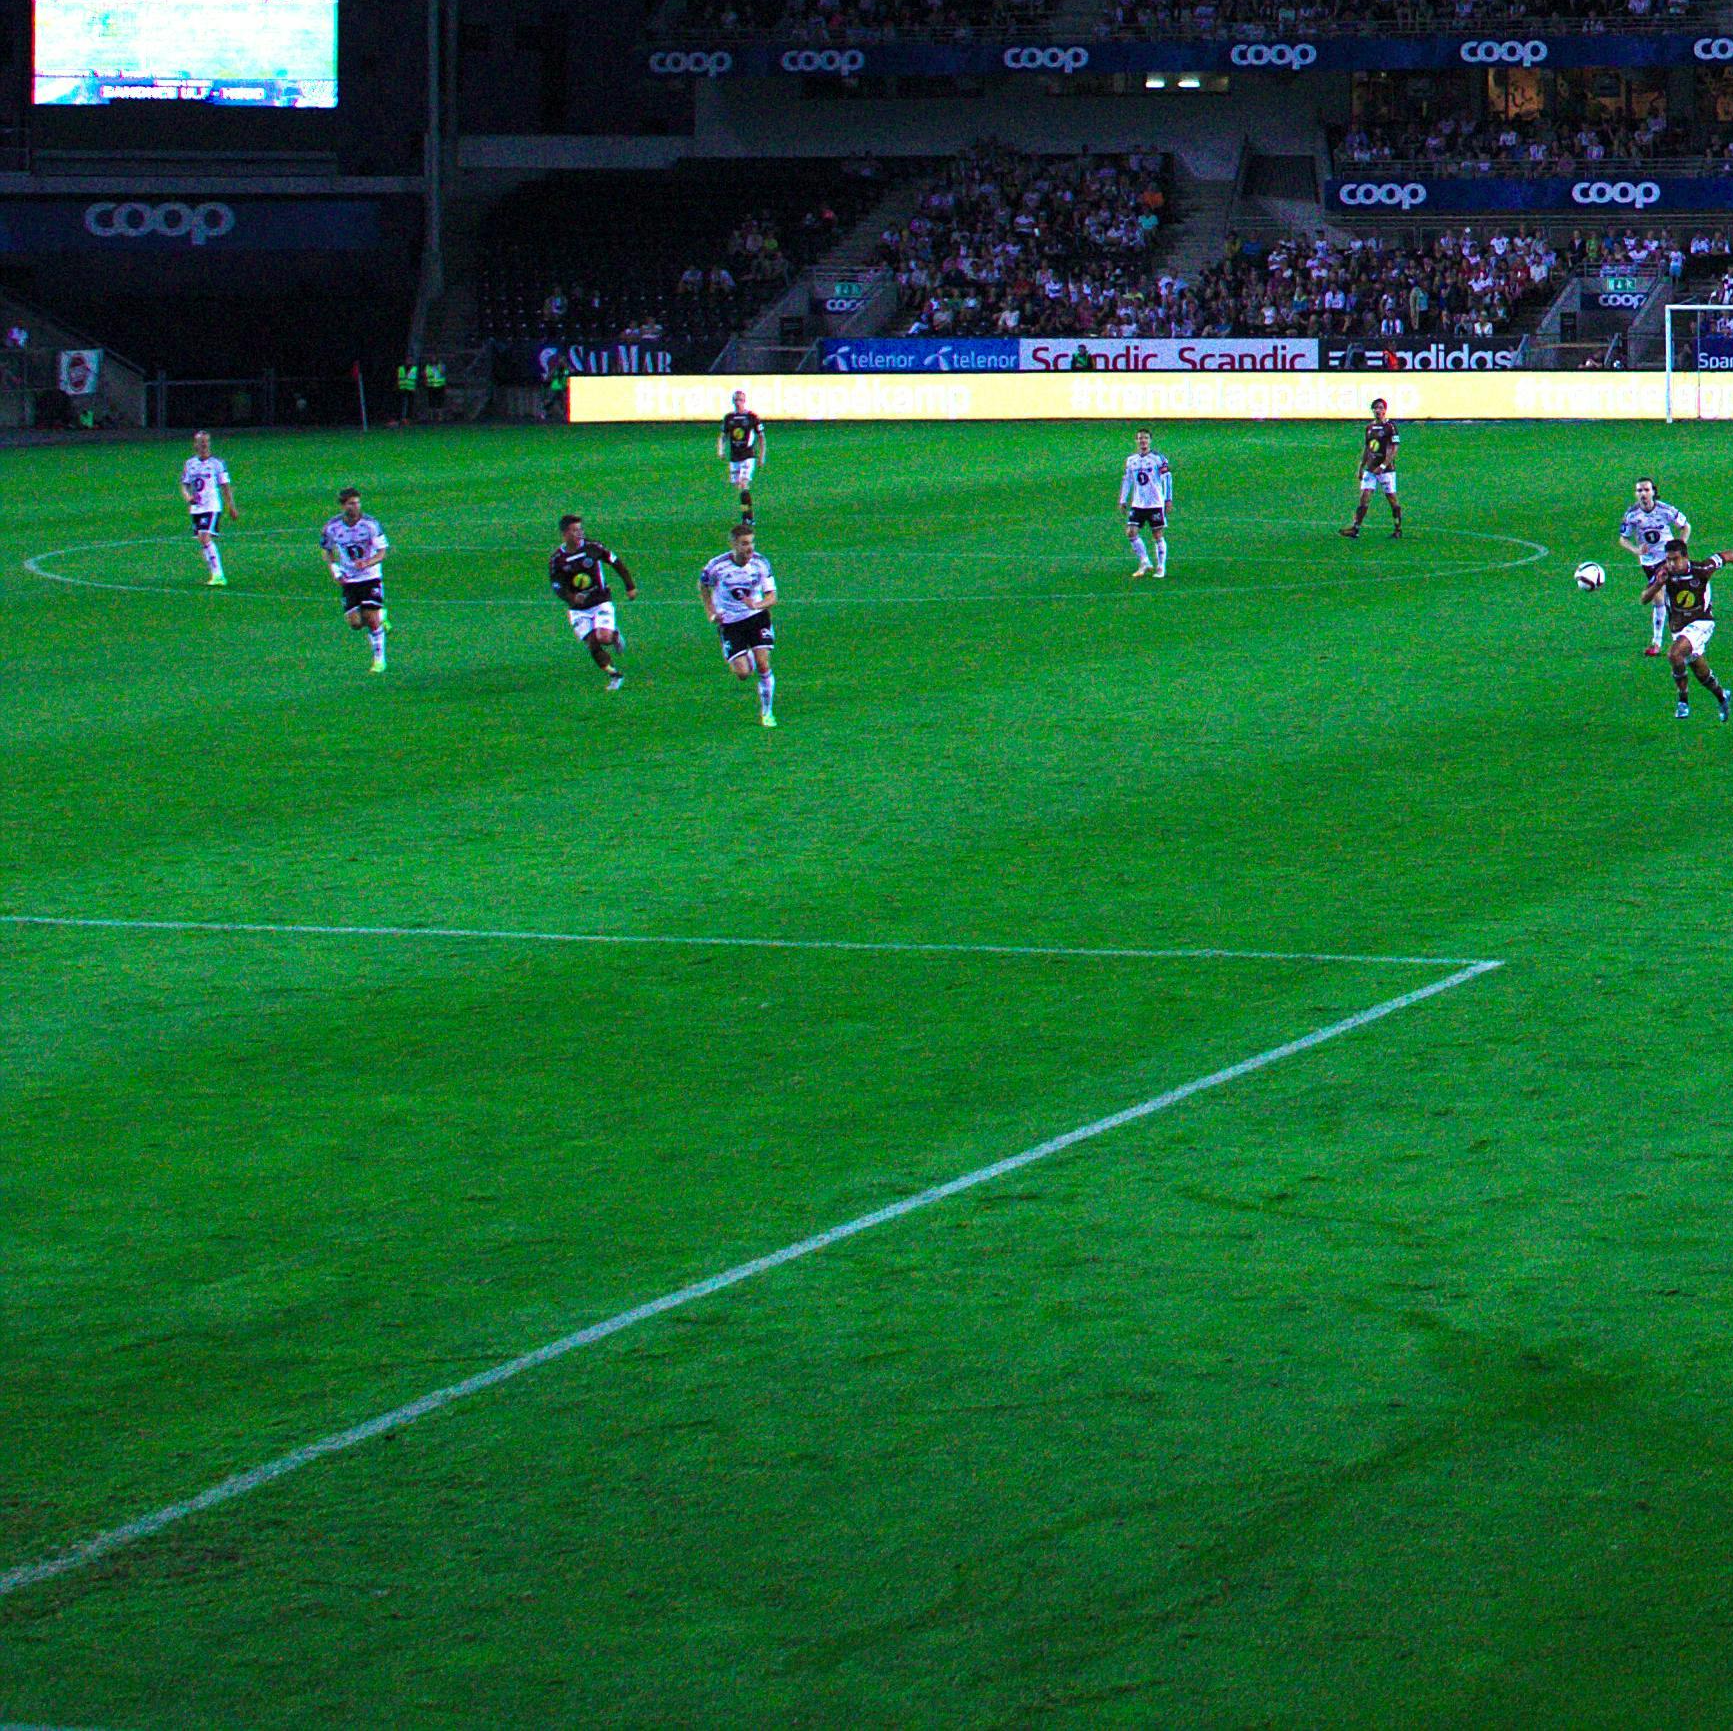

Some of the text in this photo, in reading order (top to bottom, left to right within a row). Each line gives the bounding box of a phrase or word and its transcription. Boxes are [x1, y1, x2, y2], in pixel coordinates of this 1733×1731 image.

[649, 52, 731, 77] coop
[781, 50, 863, 75] coop
[1004, 47, 1088, 73] coop
[1231, 44, 1316, 70] coop
[1461, 41, 1547, 67] coop
[1340, 183, 1426, 209] coop
[1572, 182, 1660, 208] coop
[85, 203, 232, 245] coop
[850, 347, 915, 370] telenor
[953, 347, 1017, 370] telenor
[1032, 346, 1158, 370] Scndic
[1179, 346, 1307, 370] Scandic
[1398, 344, 1515, 370] adidas
